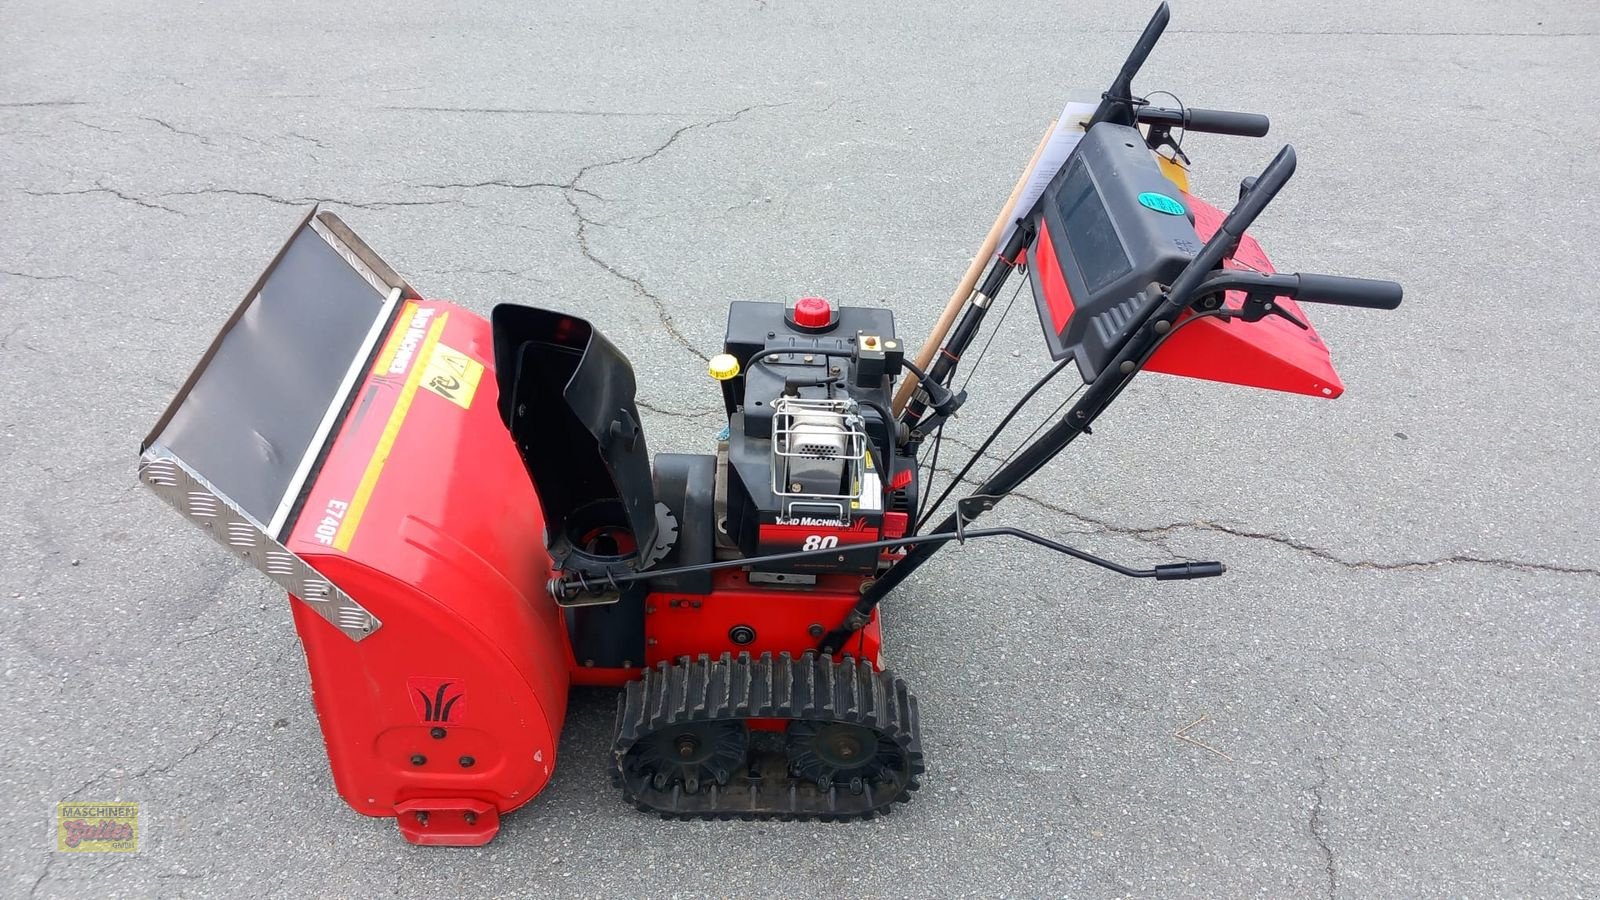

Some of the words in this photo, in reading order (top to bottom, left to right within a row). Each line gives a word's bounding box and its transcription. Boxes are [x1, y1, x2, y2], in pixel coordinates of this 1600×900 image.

[315, 500, 347, 545] E740F
[800, 517, 851, 527] MACHINES
[802, 535, 838, 551] 80
